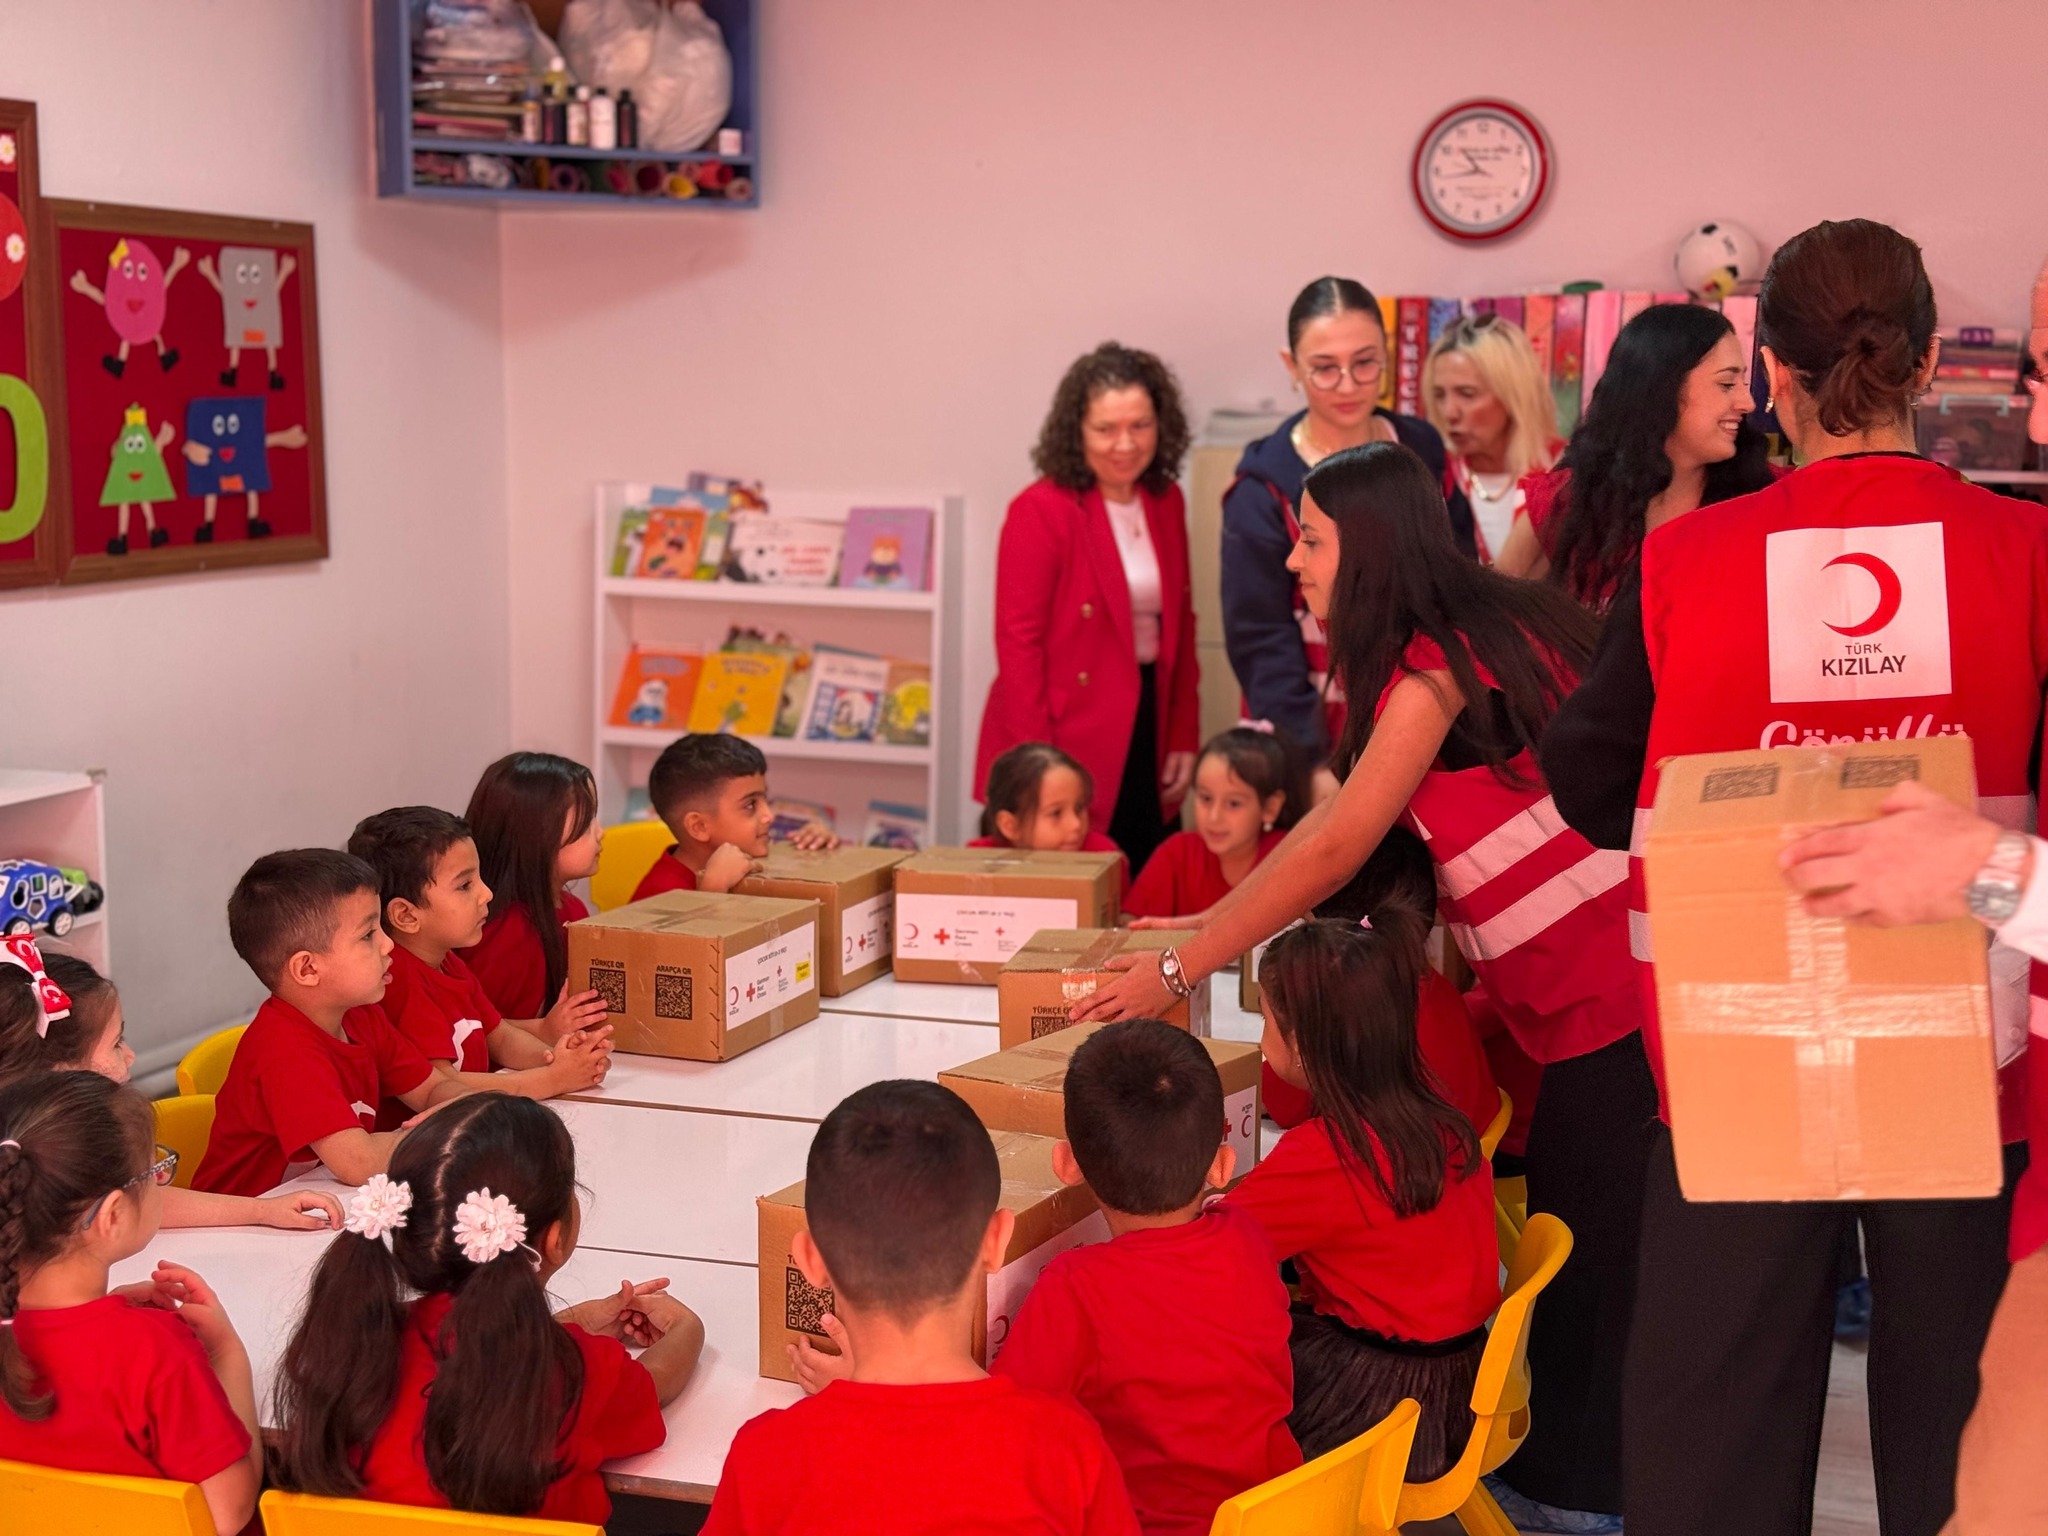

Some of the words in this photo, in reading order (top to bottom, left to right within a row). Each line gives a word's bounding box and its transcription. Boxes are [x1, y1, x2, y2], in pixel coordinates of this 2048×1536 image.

[1845, 642, 1883, 655] TÜRK
[1821, 655, 1906, 676] KIZILAY
[591, 958, 614, 968] TÜRKÇE
[615, 961, 625, 969] QR
[656, 965, 681, 974] ARAPÇA
[1032, 1005, 1061, 1016] TÜRKÇE
